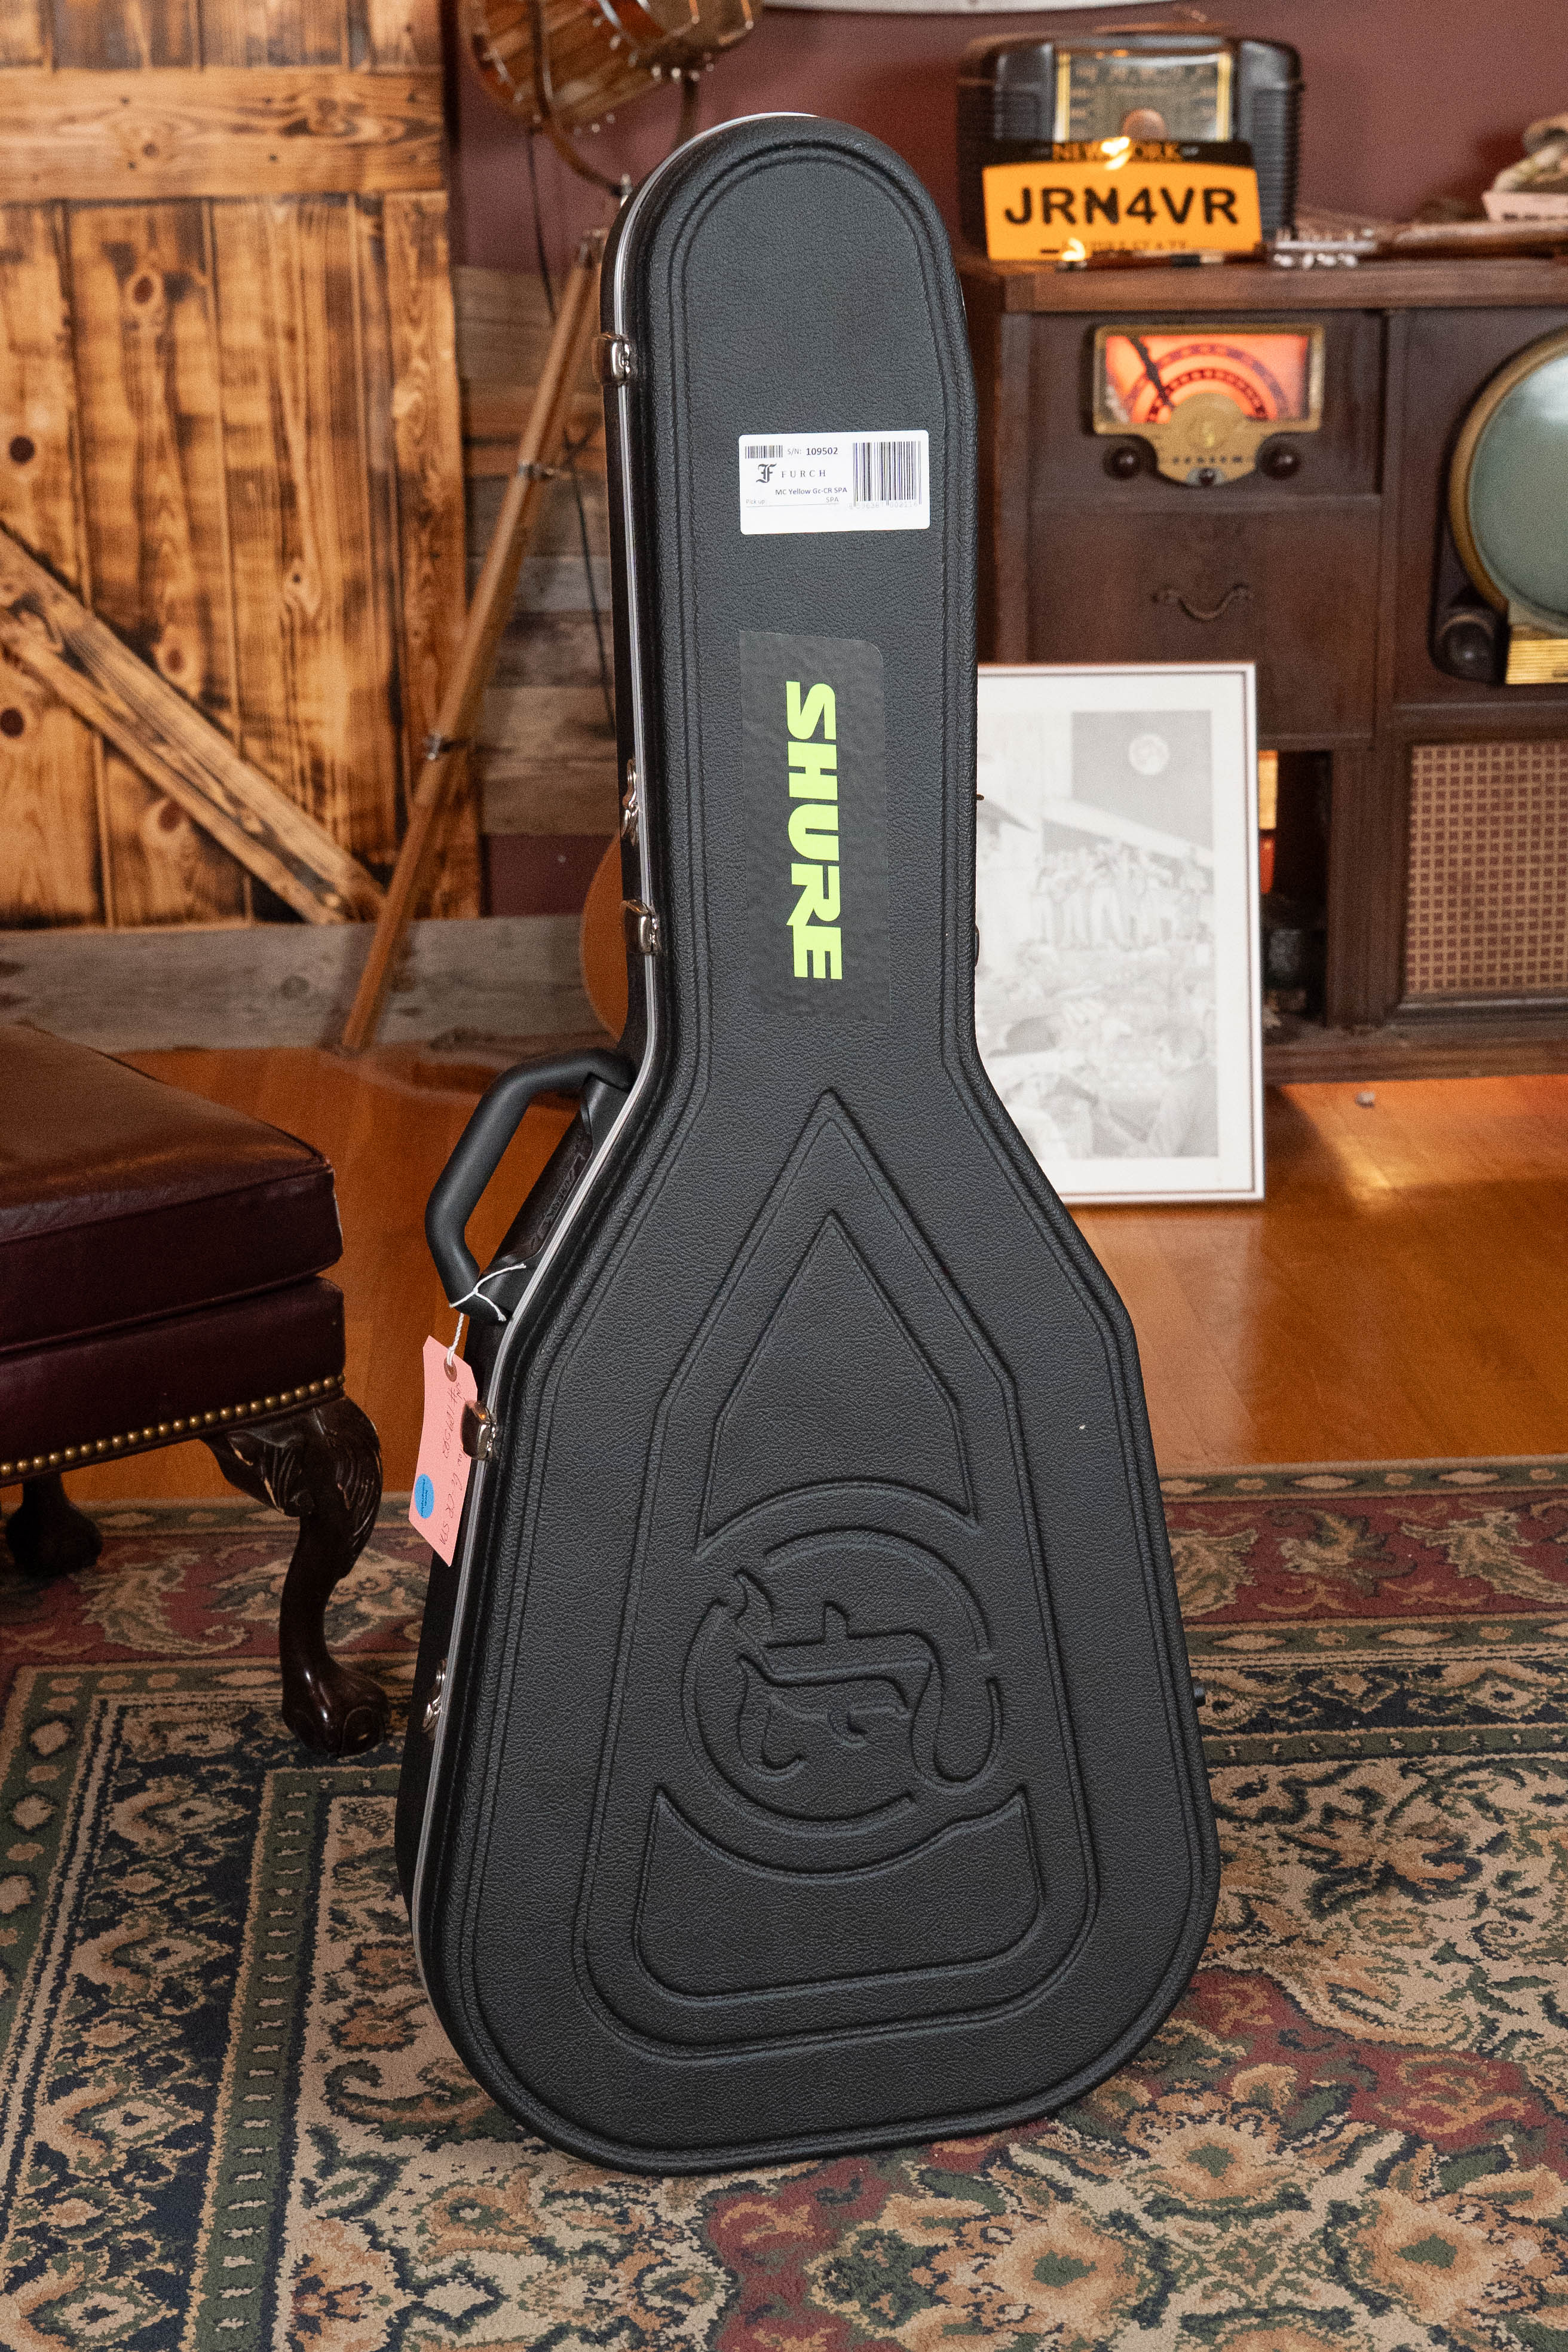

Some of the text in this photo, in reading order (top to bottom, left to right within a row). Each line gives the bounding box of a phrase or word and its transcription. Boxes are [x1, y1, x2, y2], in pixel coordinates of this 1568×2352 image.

[1004, 186, 1238, 225] JRN4VR
[806, 446, 838, 455] 109502
[782, 470, 826, 478] FURCH
[786, 681, 843, 980] SHURE
